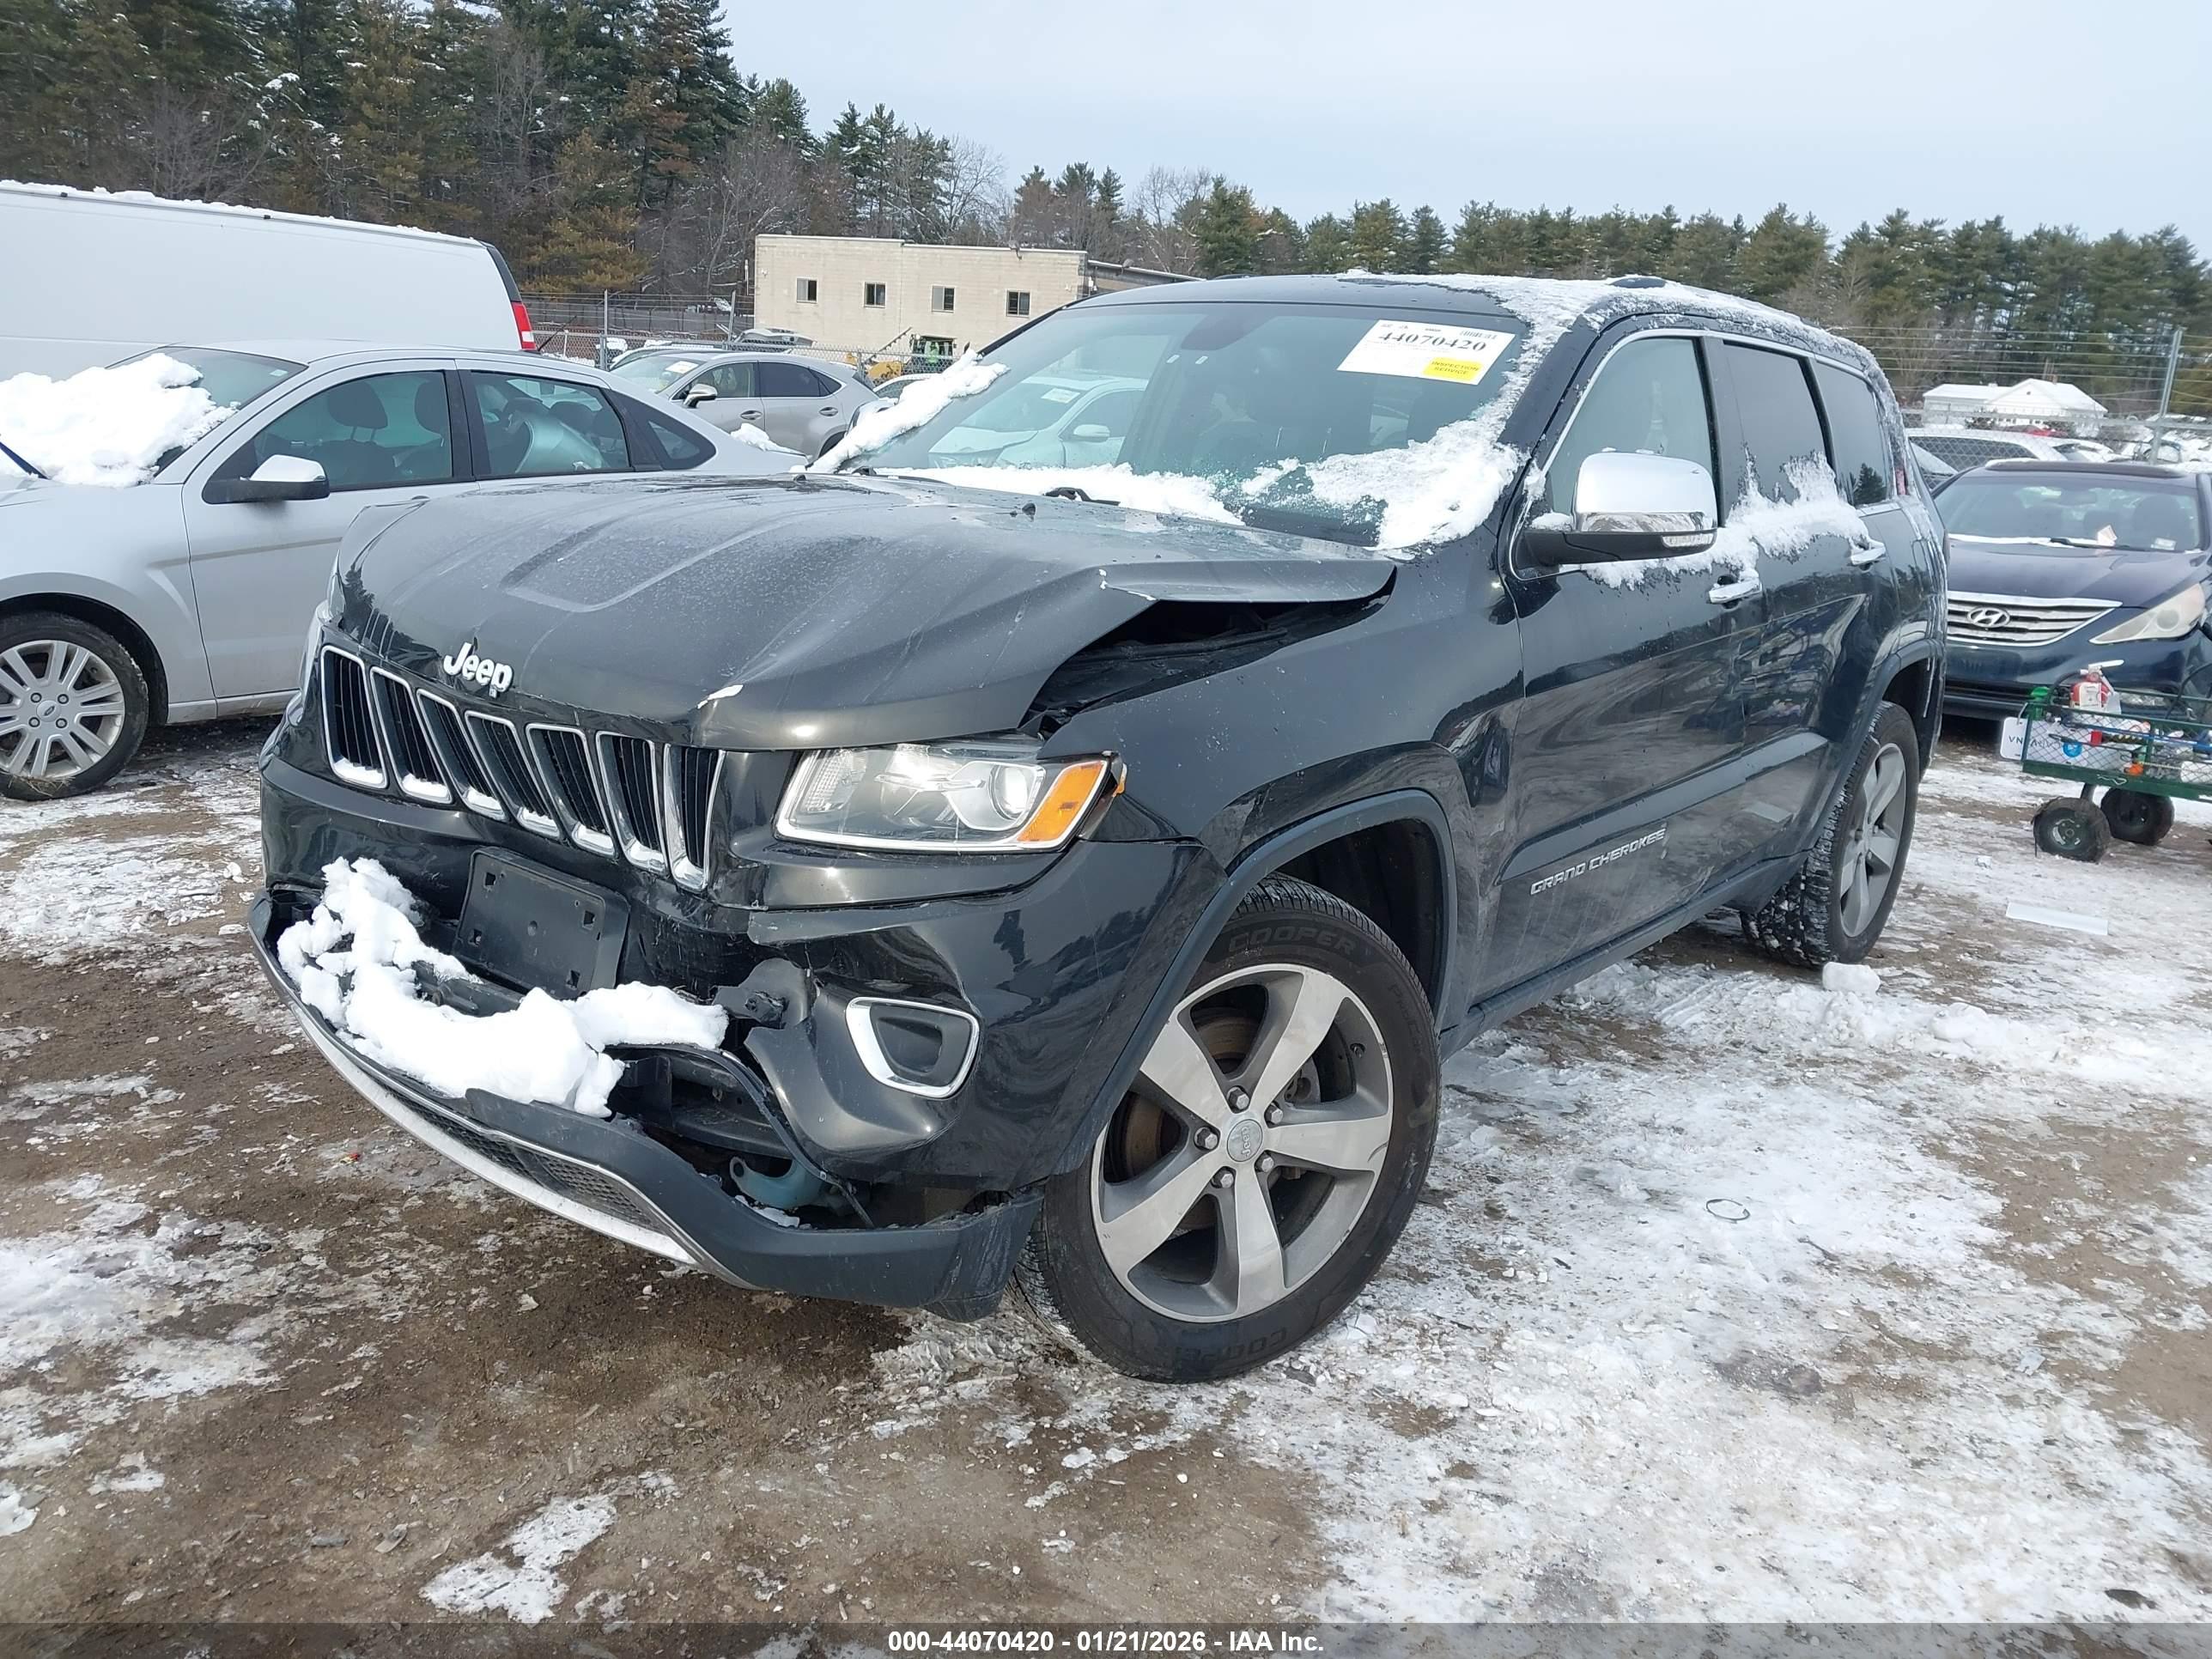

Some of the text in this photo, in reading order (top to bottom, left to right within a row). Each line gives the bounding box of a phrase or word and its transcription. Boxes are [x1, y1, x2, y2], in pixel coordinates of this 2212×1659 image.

[1378, 331, 1487, 351] 44070420
[443, 641, 513, 698] Jeep
[1530, 828, 1666, 895] GRAND CHEROKEE
[1229, 926, 1359, 955] COOPER
[1241, 1126, 1251, 1156] Jeep
